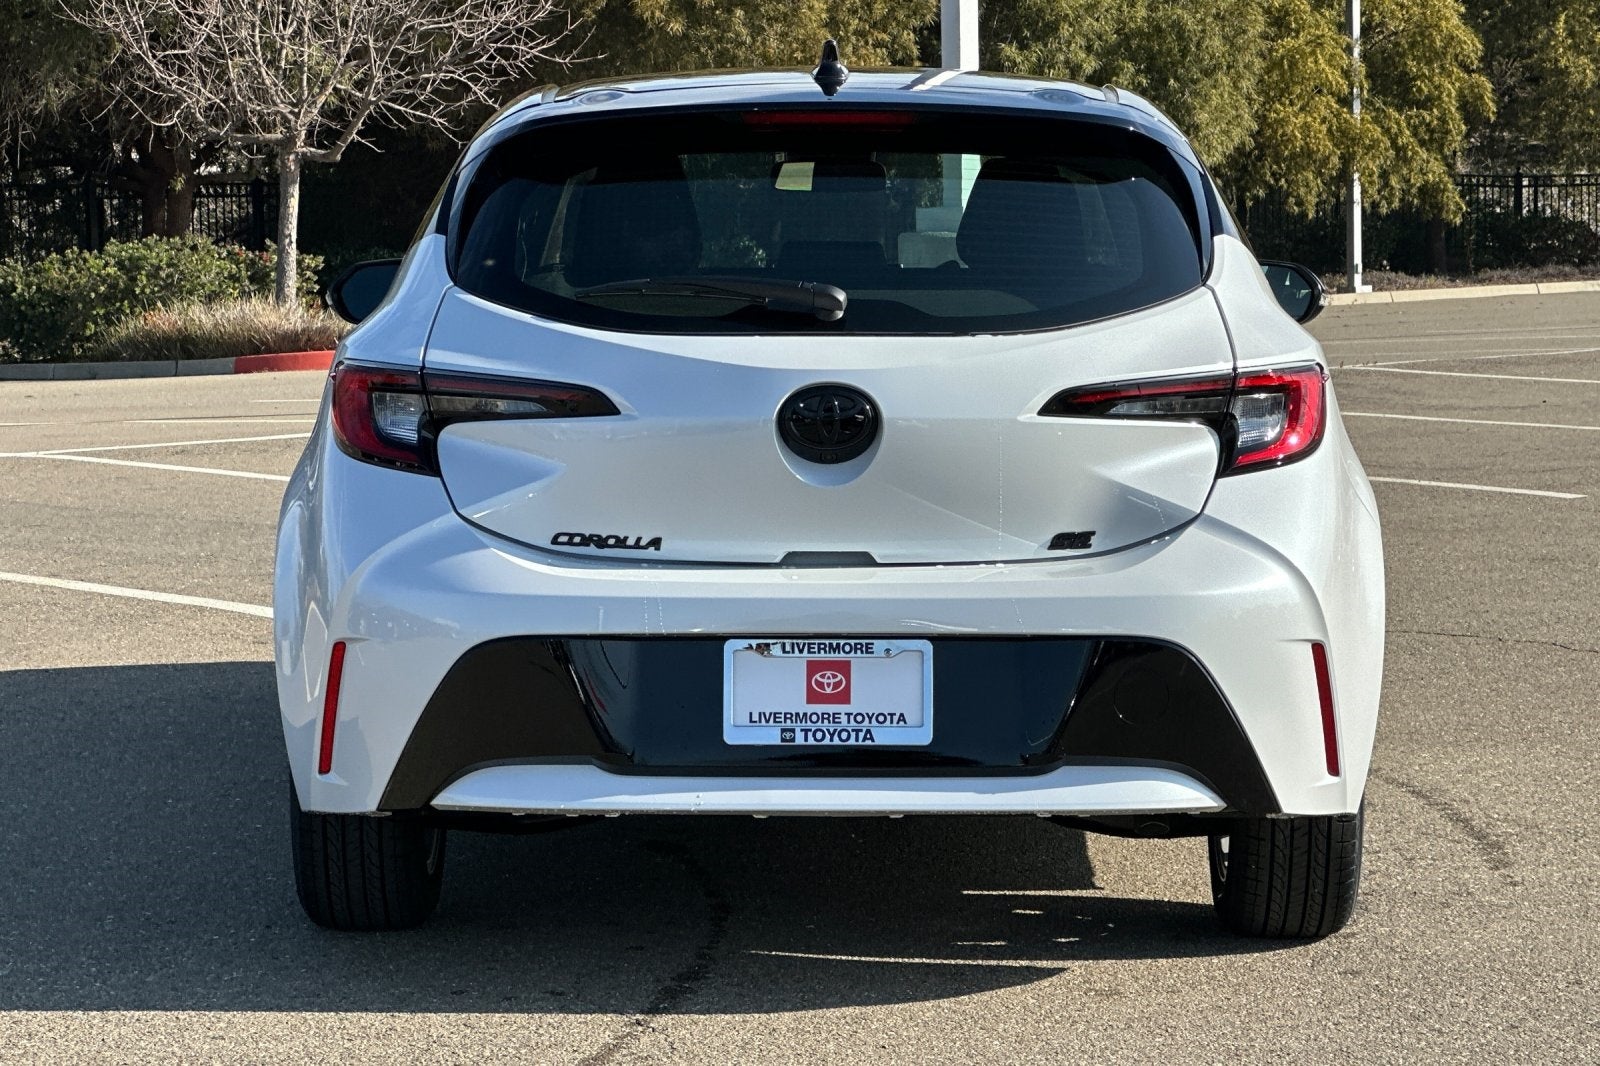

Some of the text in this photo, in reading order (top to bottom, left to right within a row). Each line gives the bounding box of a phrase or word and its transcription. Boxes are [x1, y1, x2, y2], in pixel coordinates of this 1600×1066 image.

[550, 532, 662, 551] COROLLA
[781, 642, 875, 655] LIVERMORE
[748, 711, 908, 725] LIVERMORE TOYOTA
[800, 728, 875, 743] TOYOTA
